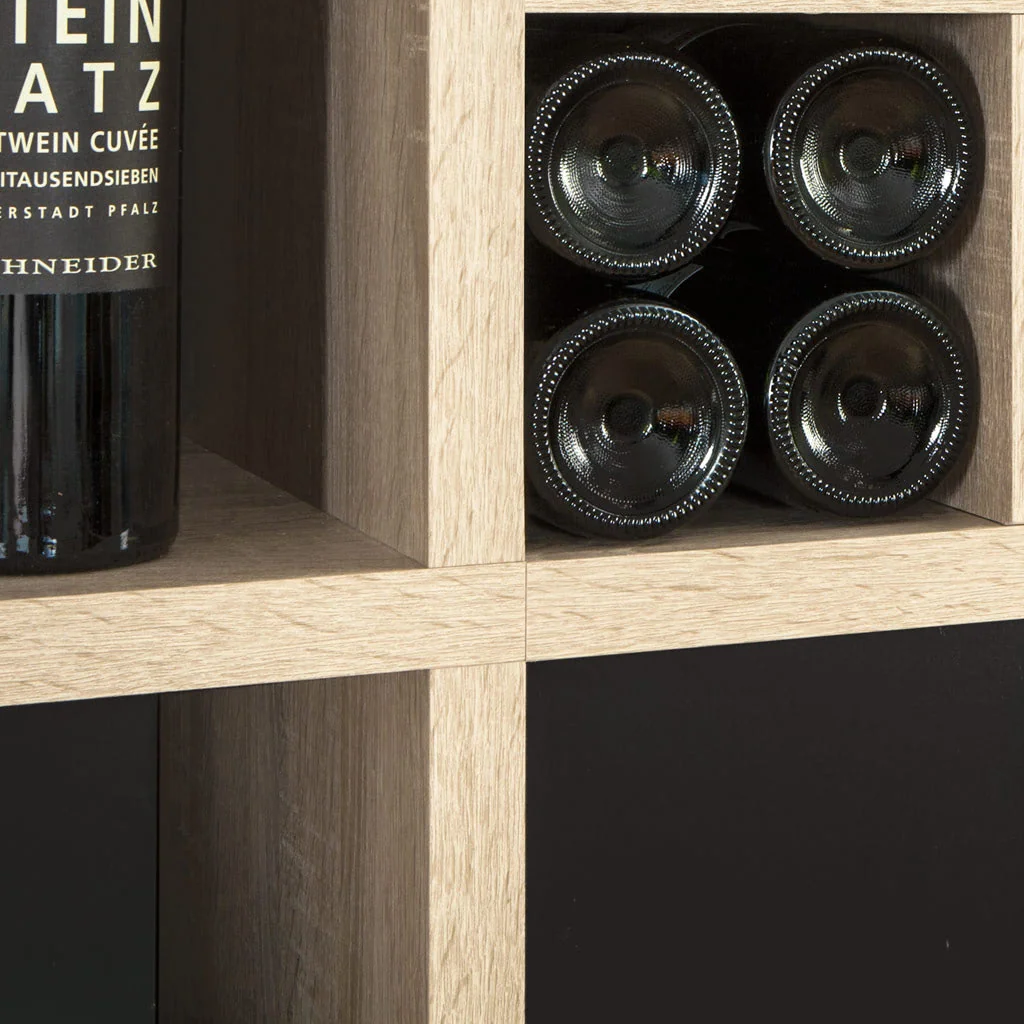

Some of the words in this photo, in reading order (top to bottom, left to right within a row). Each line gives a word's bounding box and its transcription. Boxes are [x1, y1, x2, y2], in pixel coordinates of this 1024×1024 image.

[13, 61, 161, 114] ATZ
[90, 123, 158, 152] CUVÉE
[0, 167, 158, 188] ITAUSENDSIEBEN
[0, 205, 94, 219] RSTADT
[108, 201, 158, 217] PFALZ
[1, 253, 157, 275] HNEIDER
